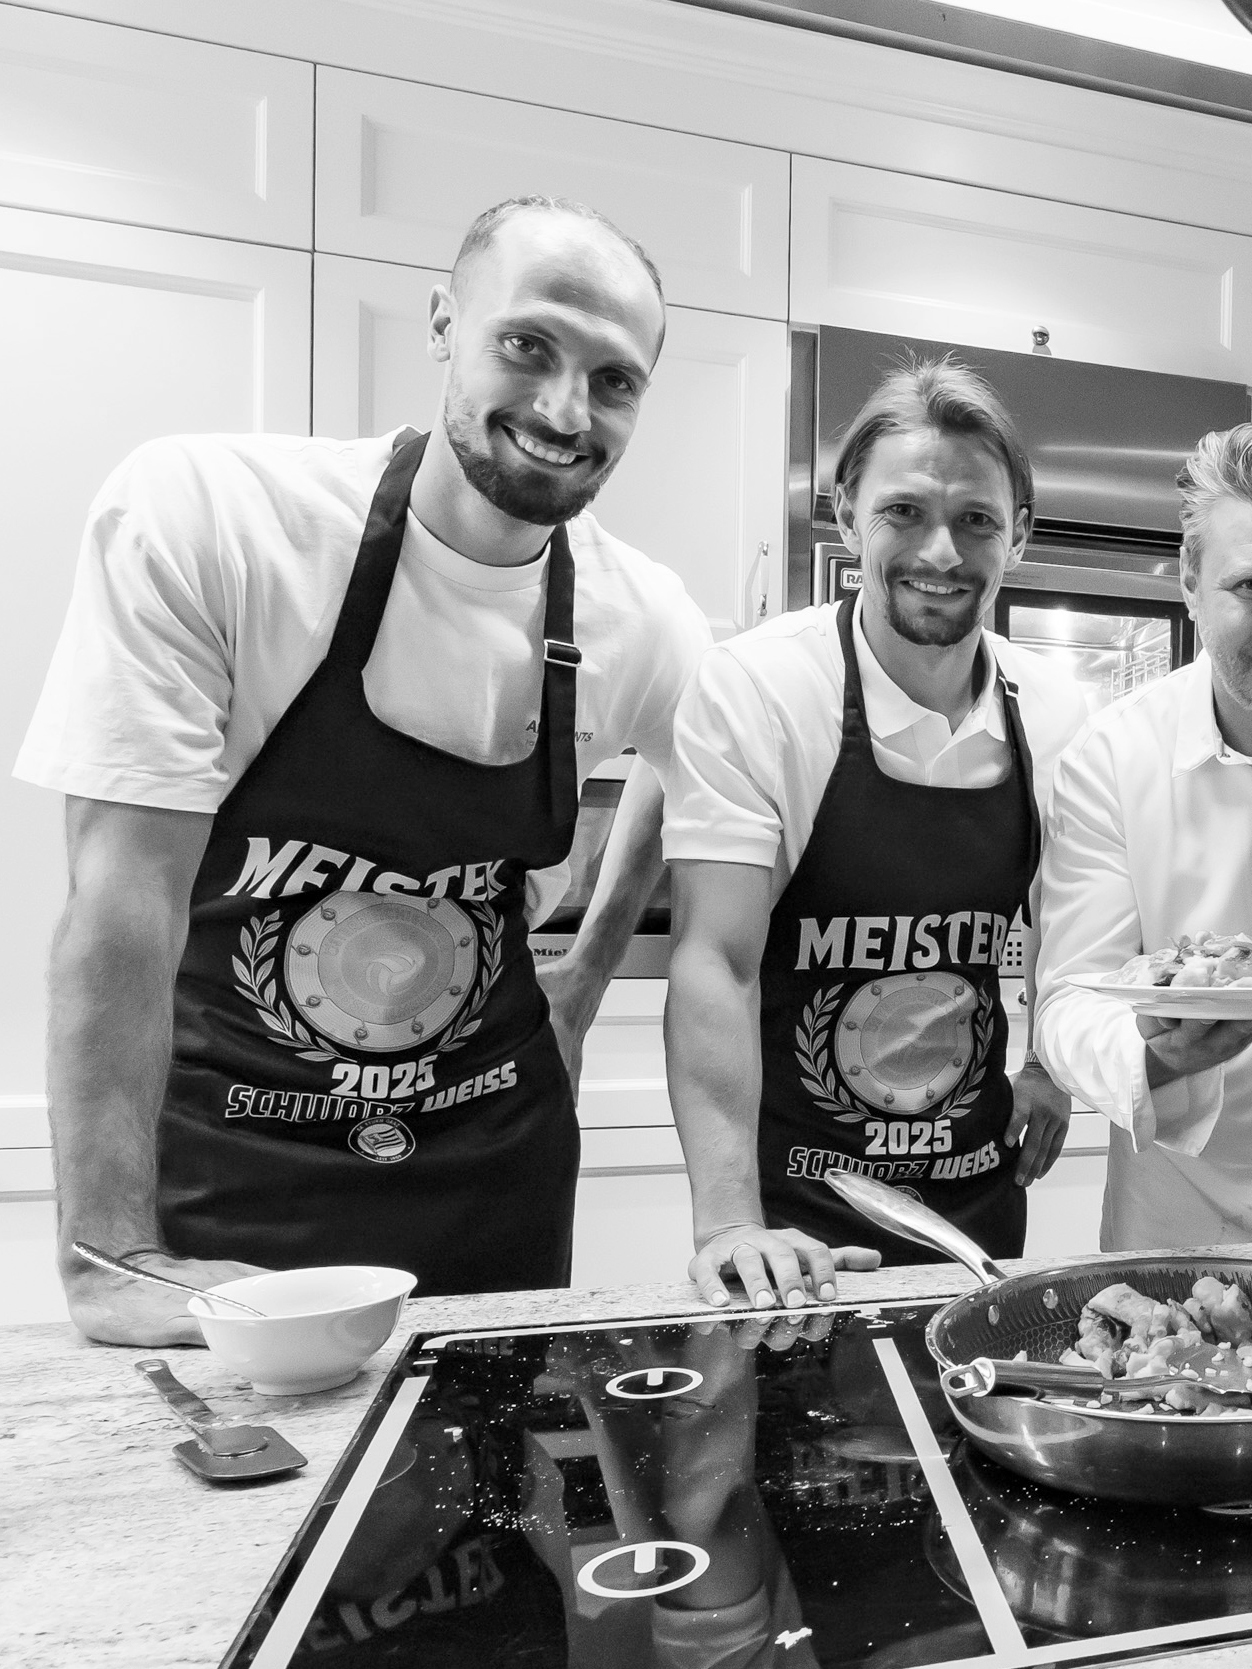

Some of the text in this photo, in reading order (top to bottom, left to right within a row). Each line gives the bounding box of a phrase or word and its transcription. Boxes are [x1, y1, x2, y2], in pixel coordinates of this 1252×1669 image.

[533, 948, 569, 957] Miel
[794, 910, 1008, 971] MEISTER
[330, 1053, 439, 1099] 2025
[421, 1060, 518, 1113] WEISS
[864, 1119, 953, 1155] 2025
[930, 1140, 1001, 1180] WEISS
